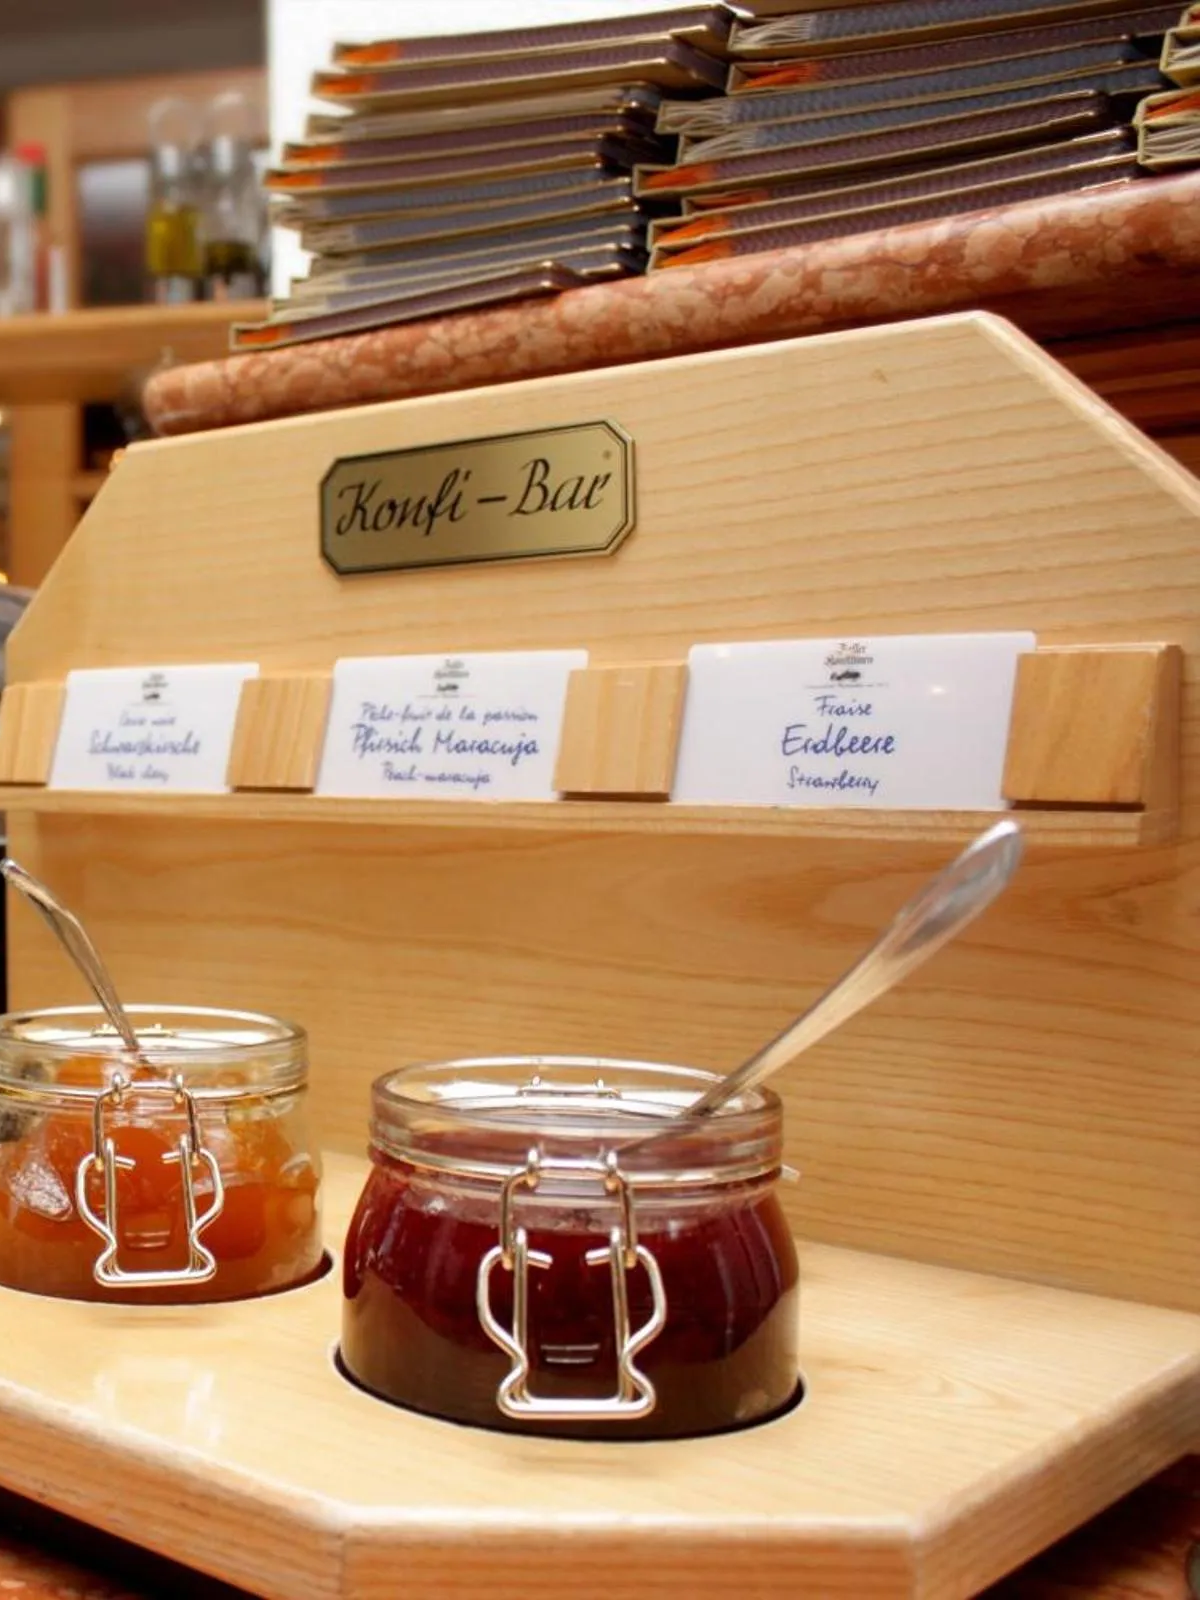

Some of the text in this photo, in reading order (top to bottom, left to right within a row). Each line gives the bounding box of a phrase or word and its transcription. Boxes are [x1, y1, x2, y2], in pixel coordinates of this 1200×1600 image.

[814, 694, 872, 717] Fraise
[432, 729, 540, 766] Maracuja
[781, 724, 895, 756] Erdbeere
